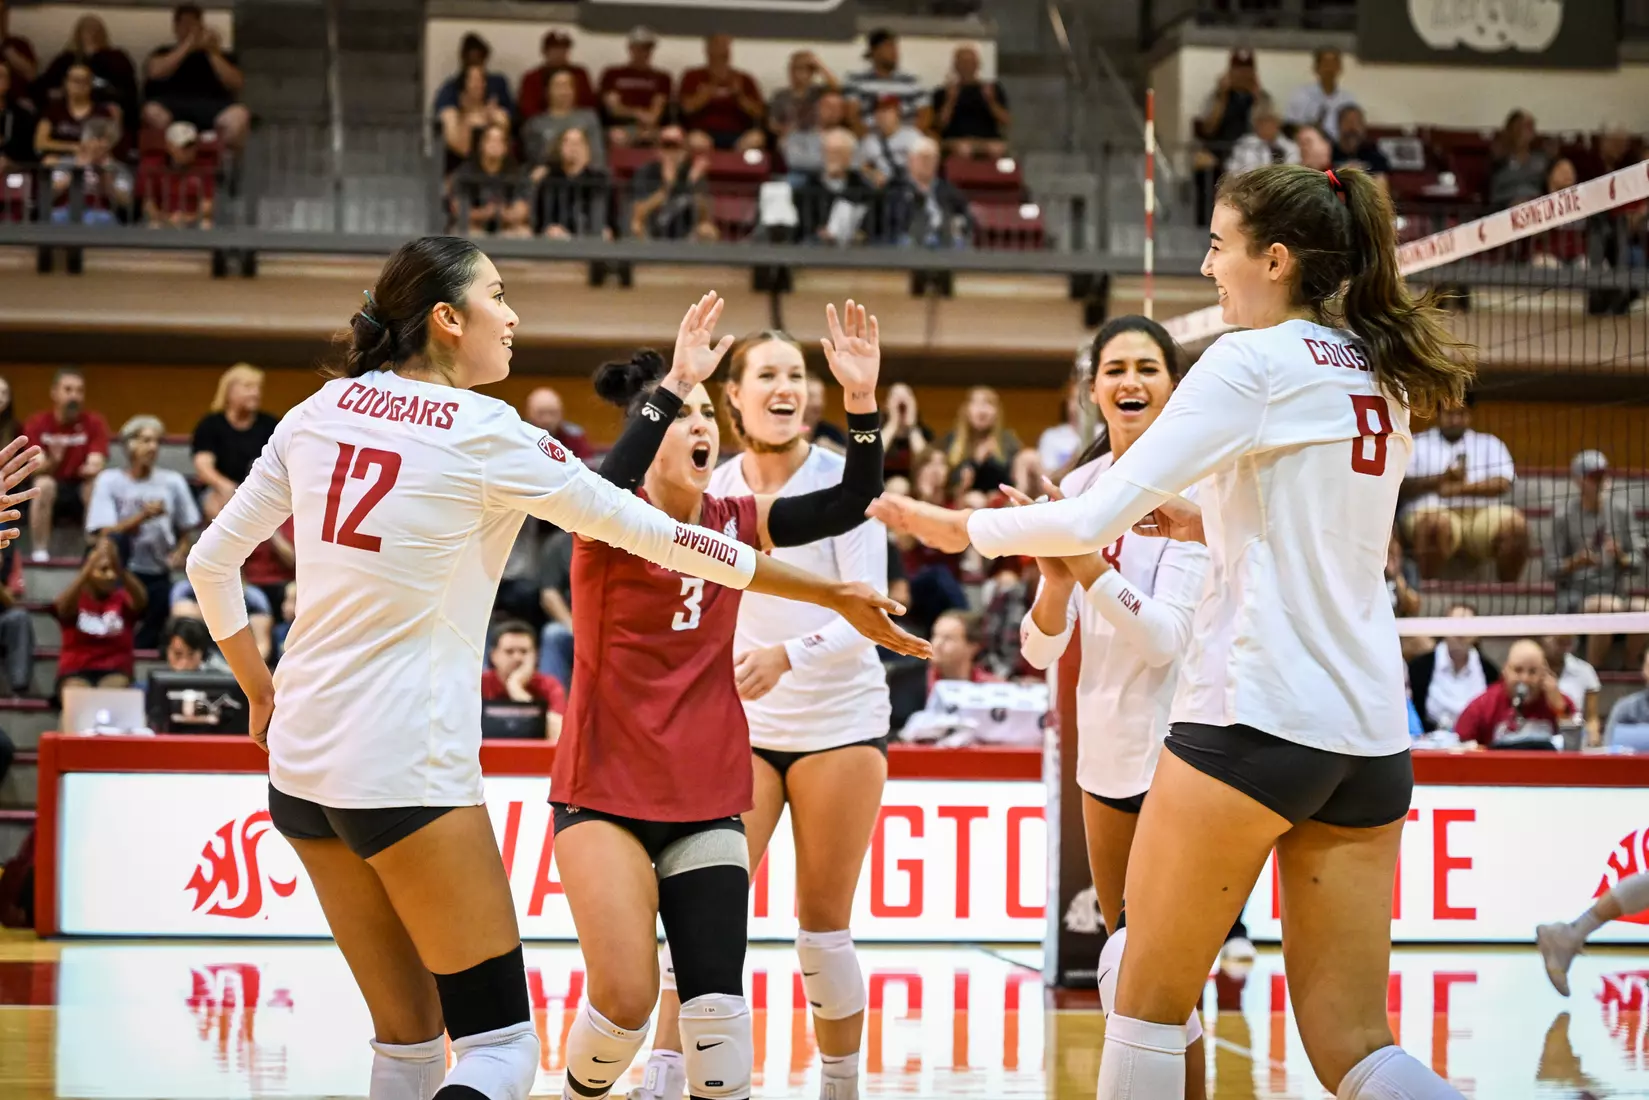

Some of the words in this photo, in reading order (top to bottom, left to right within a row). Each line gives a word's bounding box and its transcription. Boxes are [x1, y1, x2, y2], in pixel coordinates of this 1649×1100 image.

[1303, 337, 1375, 372] COUG
[336, 382, 460, 430] COUGARS
[1347, 394, 1394, 477] 8
[321, 441, 403, 553] 12
[672, 525, 738, 568] COUGARS
[671, 576, 705, 632] 3
[1117, 587, 1142, 616] WSU
